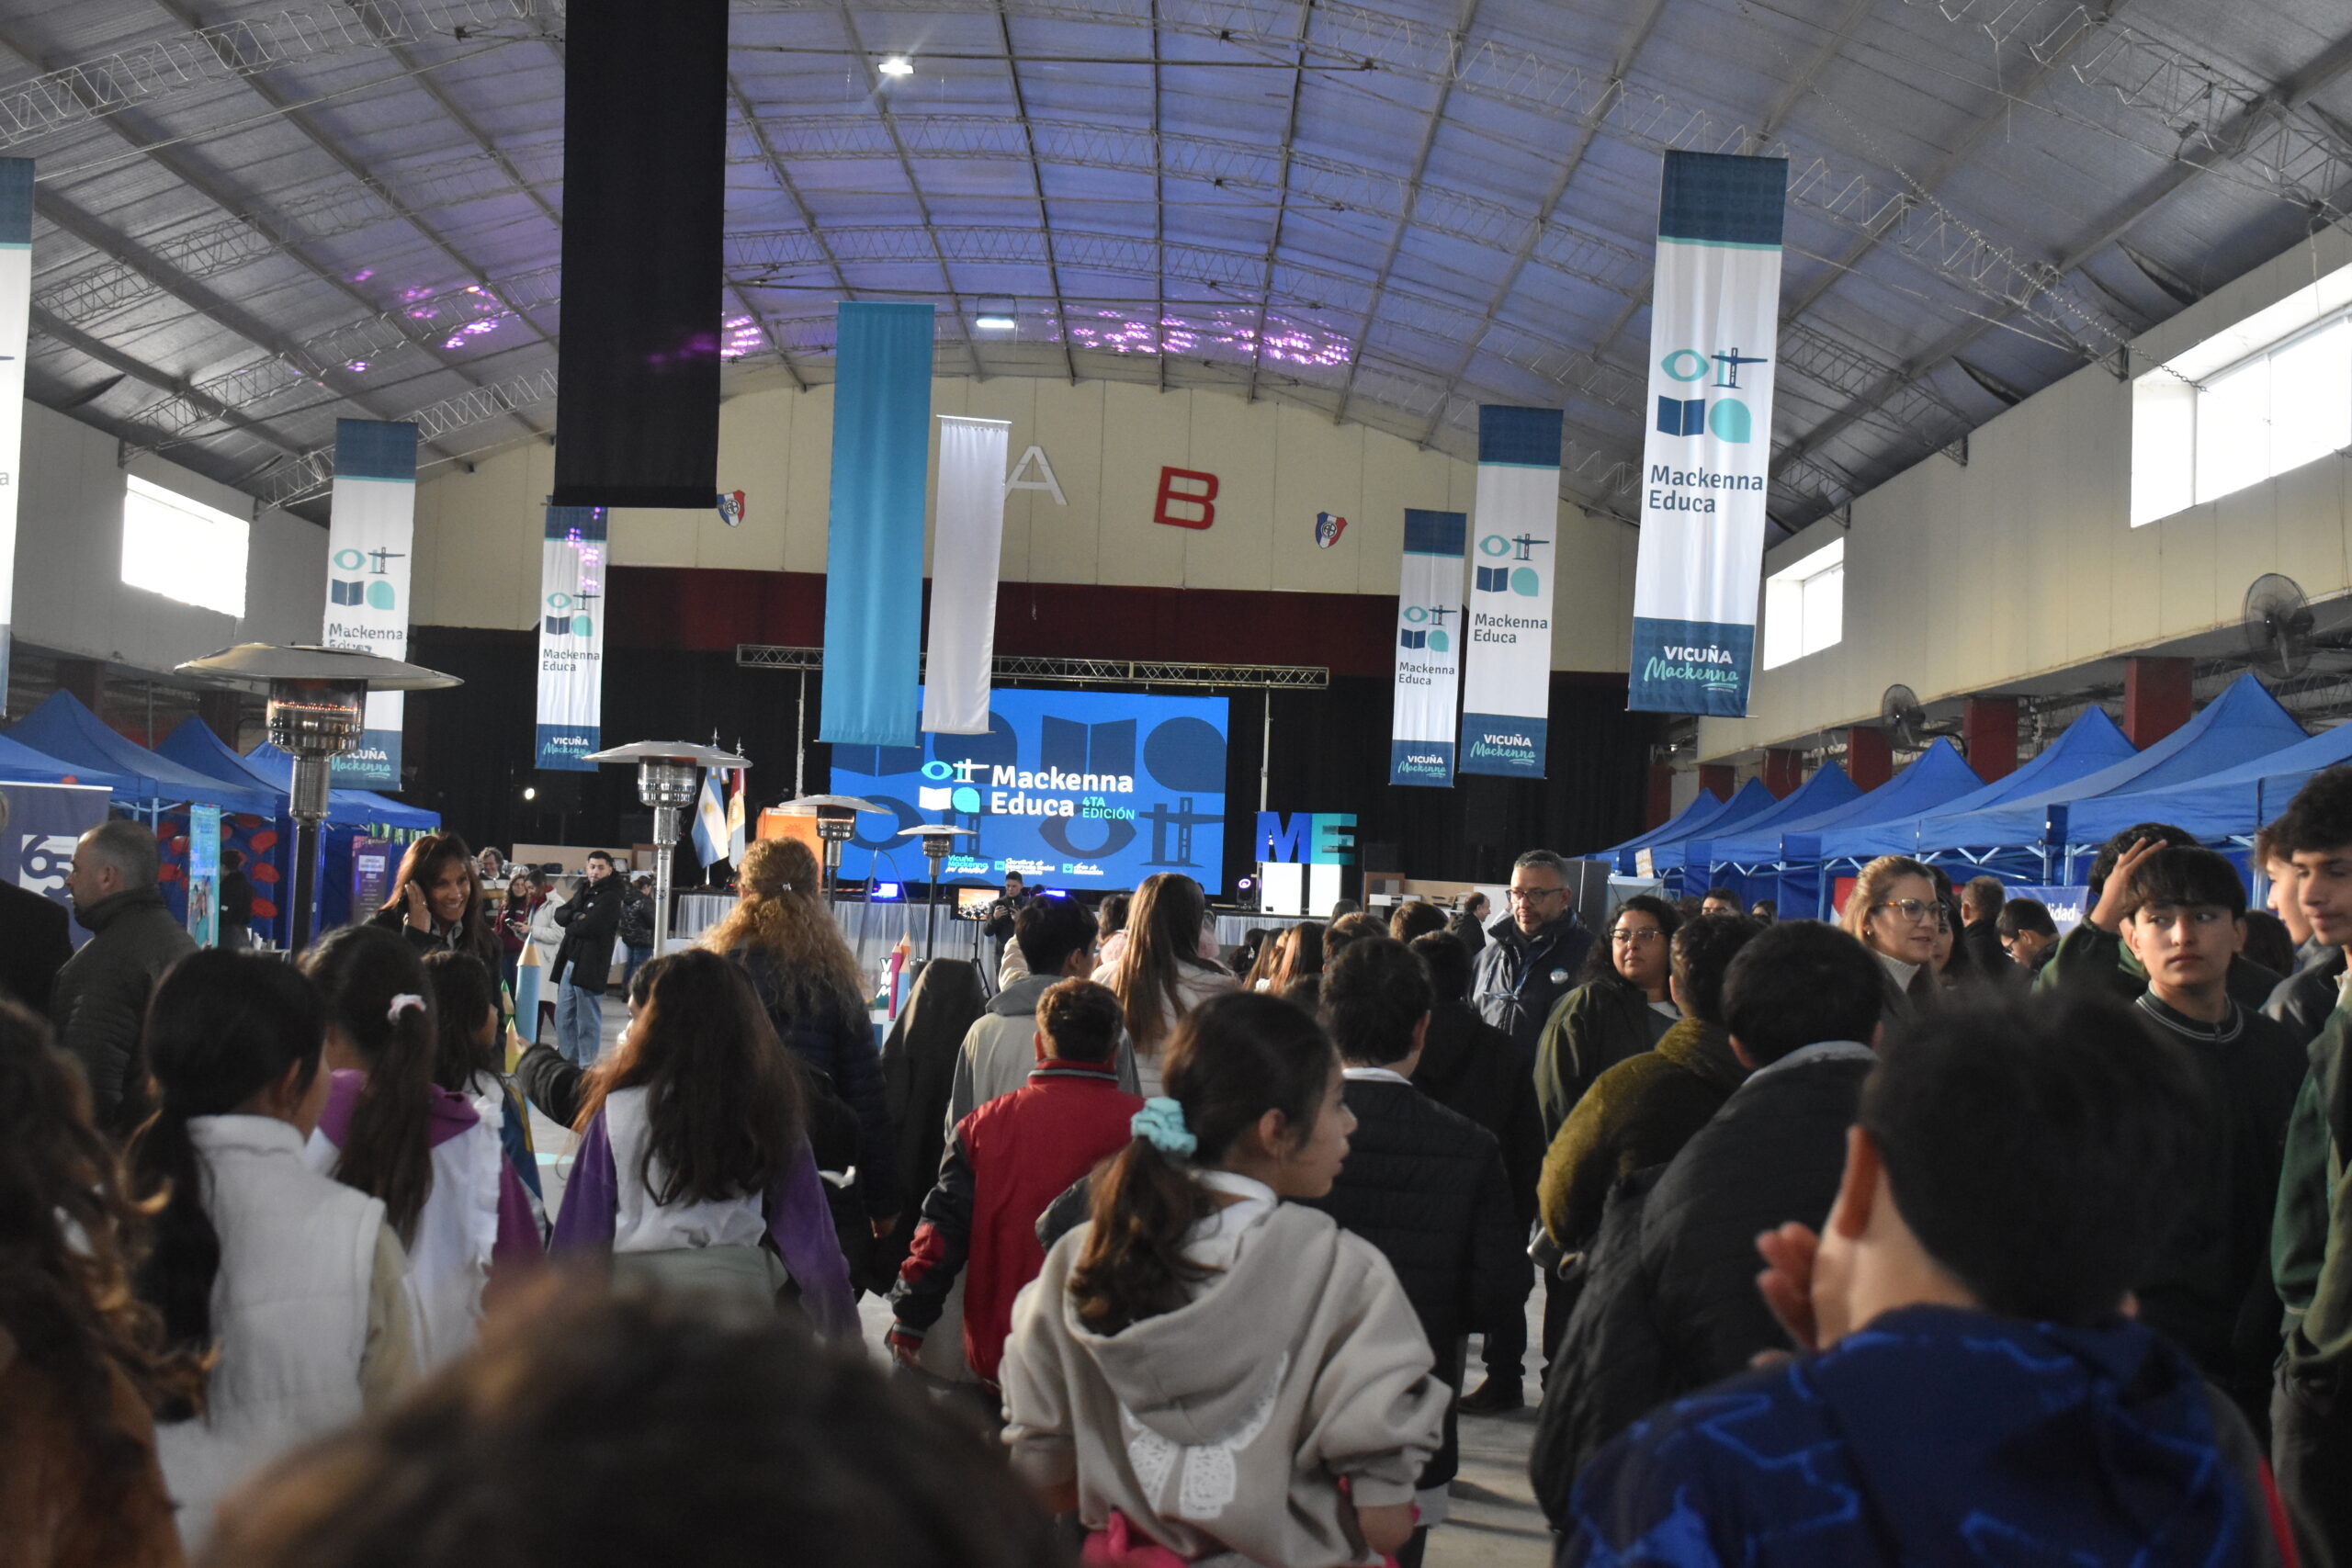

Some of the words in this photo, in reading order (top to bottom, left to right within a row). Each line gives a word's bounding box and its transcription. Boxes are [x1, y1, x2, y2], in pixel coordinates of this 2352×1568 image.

[1650, 465, 1763, 491] Mackenna
[1154, 466, 1219, 530] B
[1649, 490, 1715, 513] Educa
[1475, 613, 1548, 629] Mackenna
[329, 623, 403, 640] Mackenna
[1474, 628, 1517, 644] Educa
[543, 649, 600, 660] Mackenna
[1664, 645, 1733, 664] VICUÑA
[542, 660, 577, 671] Educa
[1399, 661, 1455, 675] Mackenna
[1644, 656, 1739, 682] Mackenna
[1398, 673, 1431, 685] Educa
[552, 736, 589, 746] VICUÑA
[1483, 734, 1532, 747] VICUÑA
[347, 748, 388, 761] CUÑA
[1470, 740, 1536, 759] Mackenna
[1397, 761, 1447, 773] Mackenna
[1407, 755, 1443, 764] VICUÑA
[991, 765, 1133, 793] Mackenna
[990, 791, 1075, 818] Educa
[1082, 796, 1105, 807] 4TA
[1082, 807, 1135, 820] EDICIÓN
[1255, 811, 1357, 865] ME
[2048, 902, 2076, 921] lidad
